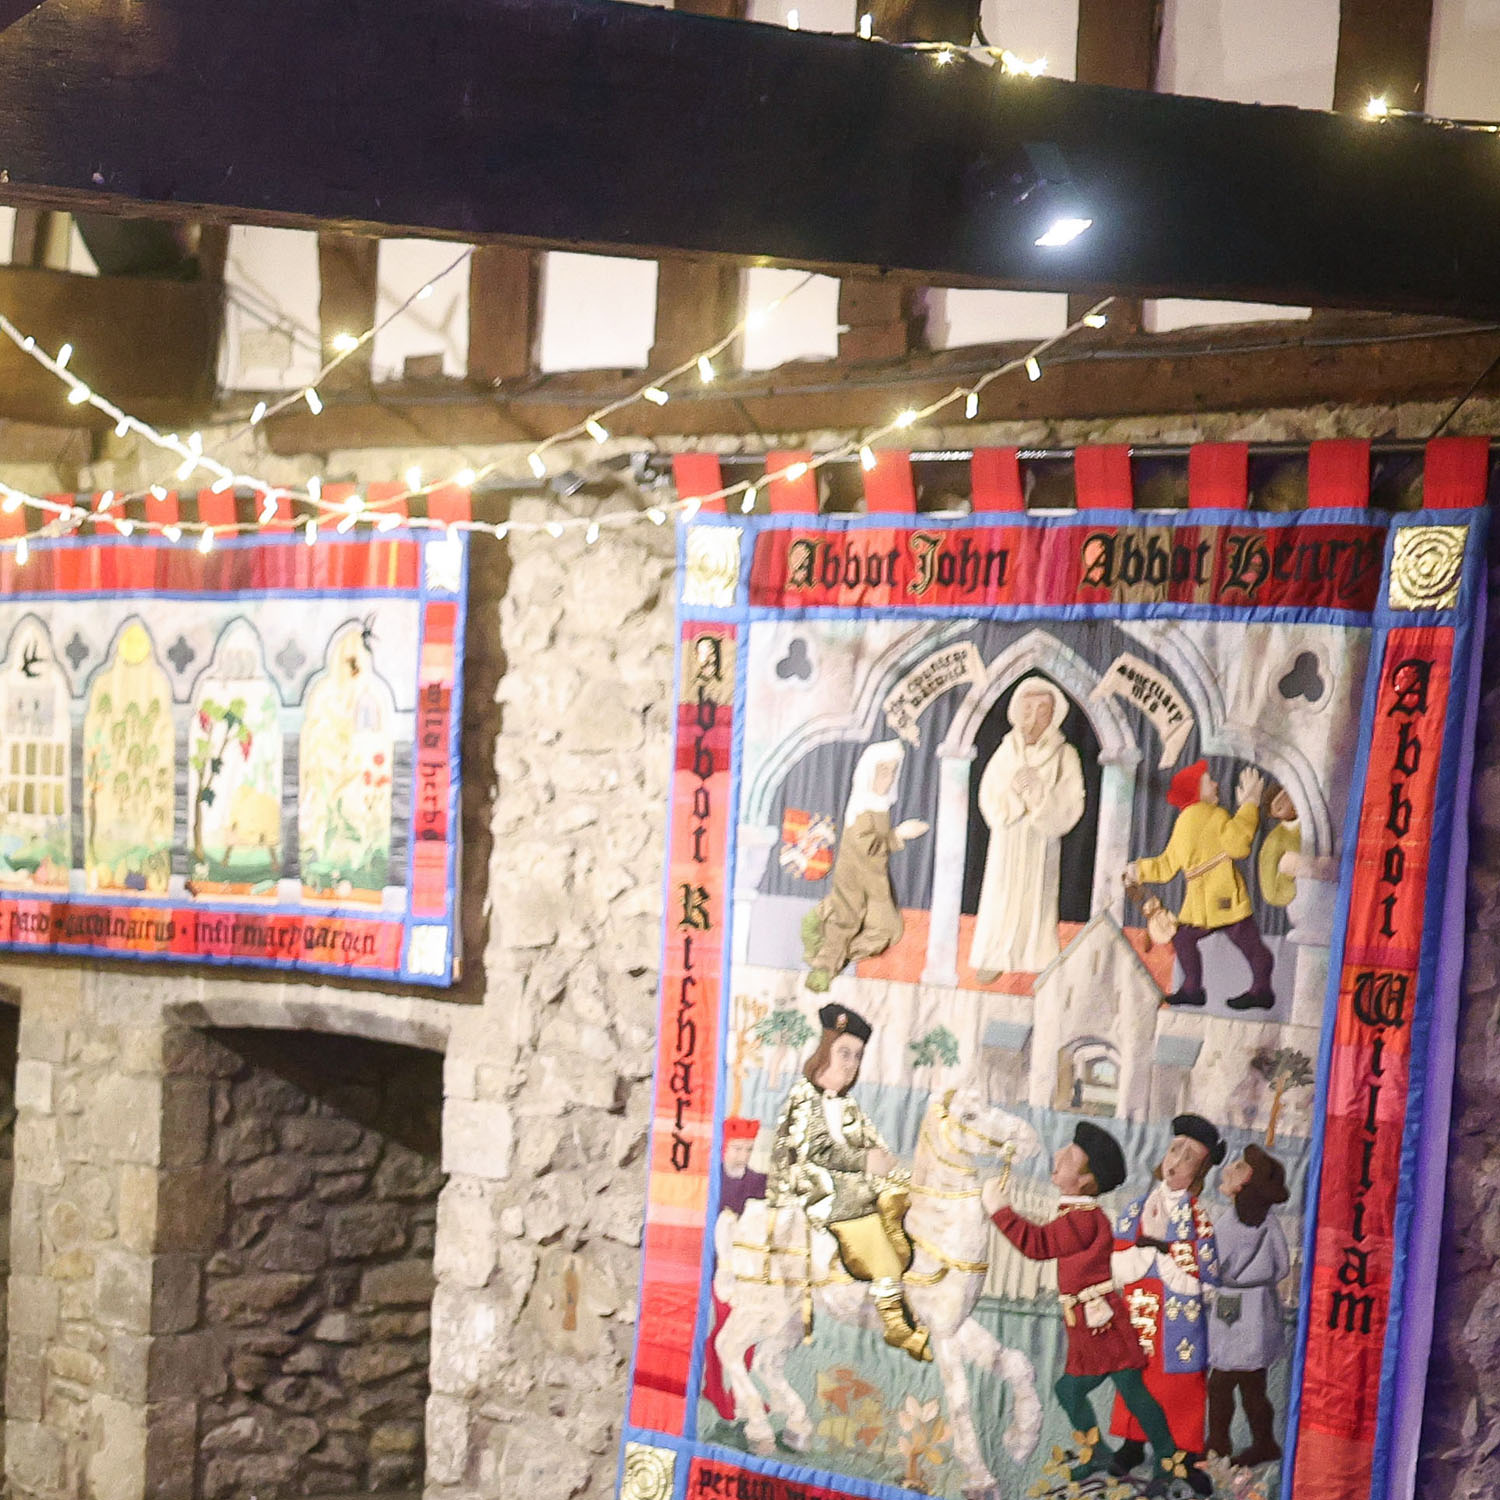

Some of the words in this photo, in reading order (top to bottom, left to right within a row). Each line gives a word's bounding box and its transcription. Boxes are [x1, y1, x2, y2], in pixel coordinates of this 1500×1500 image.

[786, 538, 899, 590] Abbot
[908, 531, 1010, 594] John
[1079, 532, 1212, 587] Abbot
[1222, 535, 1382, 600] Henry
[692, 637, 722, 863] Abbot
[1379, 659, 1435, 938] Abbot
[670, 883, 711, 1172] Richard
[1328, 971, 1408, 1334] William
